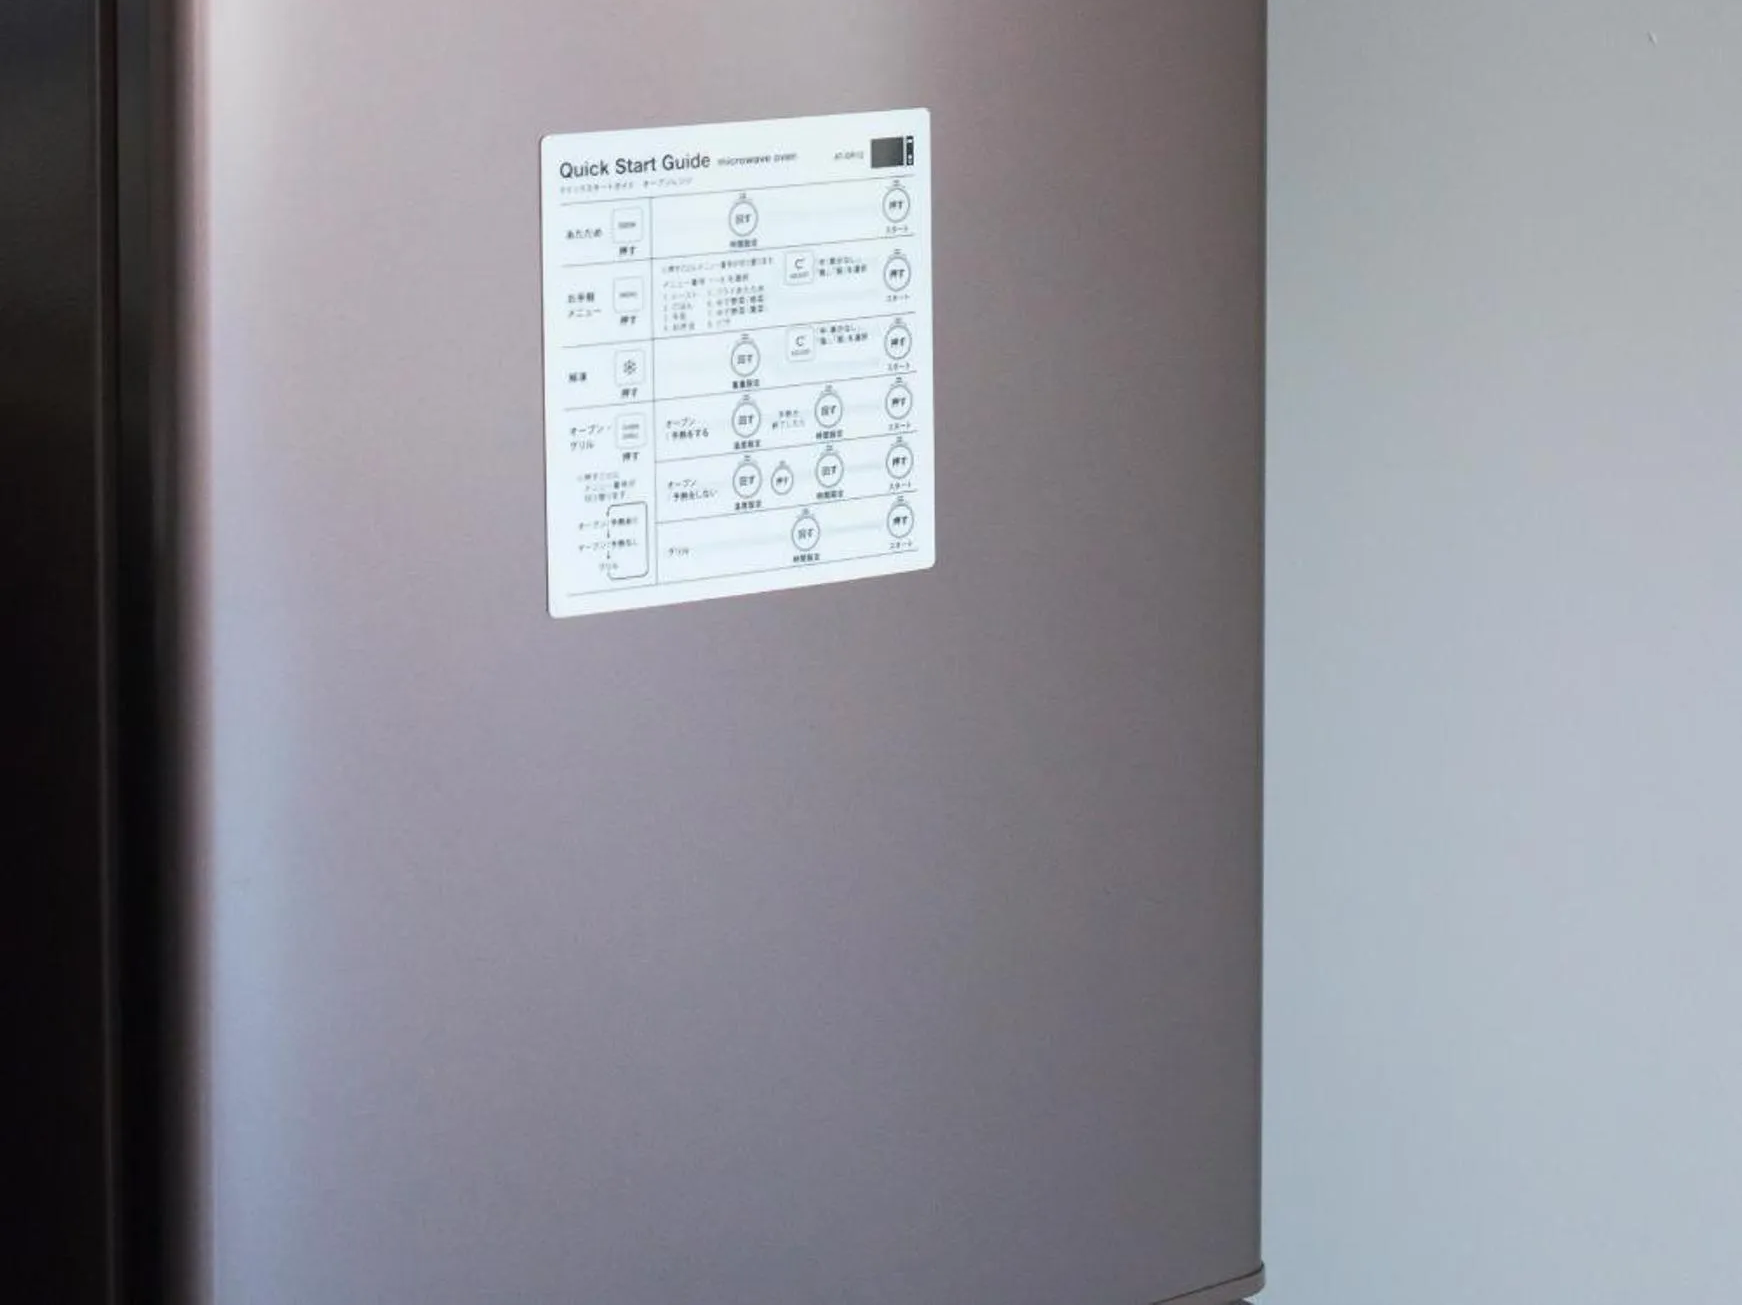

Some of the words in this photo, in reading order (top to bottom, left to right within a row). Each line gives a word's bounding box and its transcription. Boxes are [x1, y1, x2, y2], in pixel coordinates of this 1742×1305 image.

[559, 160, 610, 179] Quick
[615, 157, 656, 174] Start
[662, 152, 711, 170] Guide
[717, 155, 770, 166] microwave
